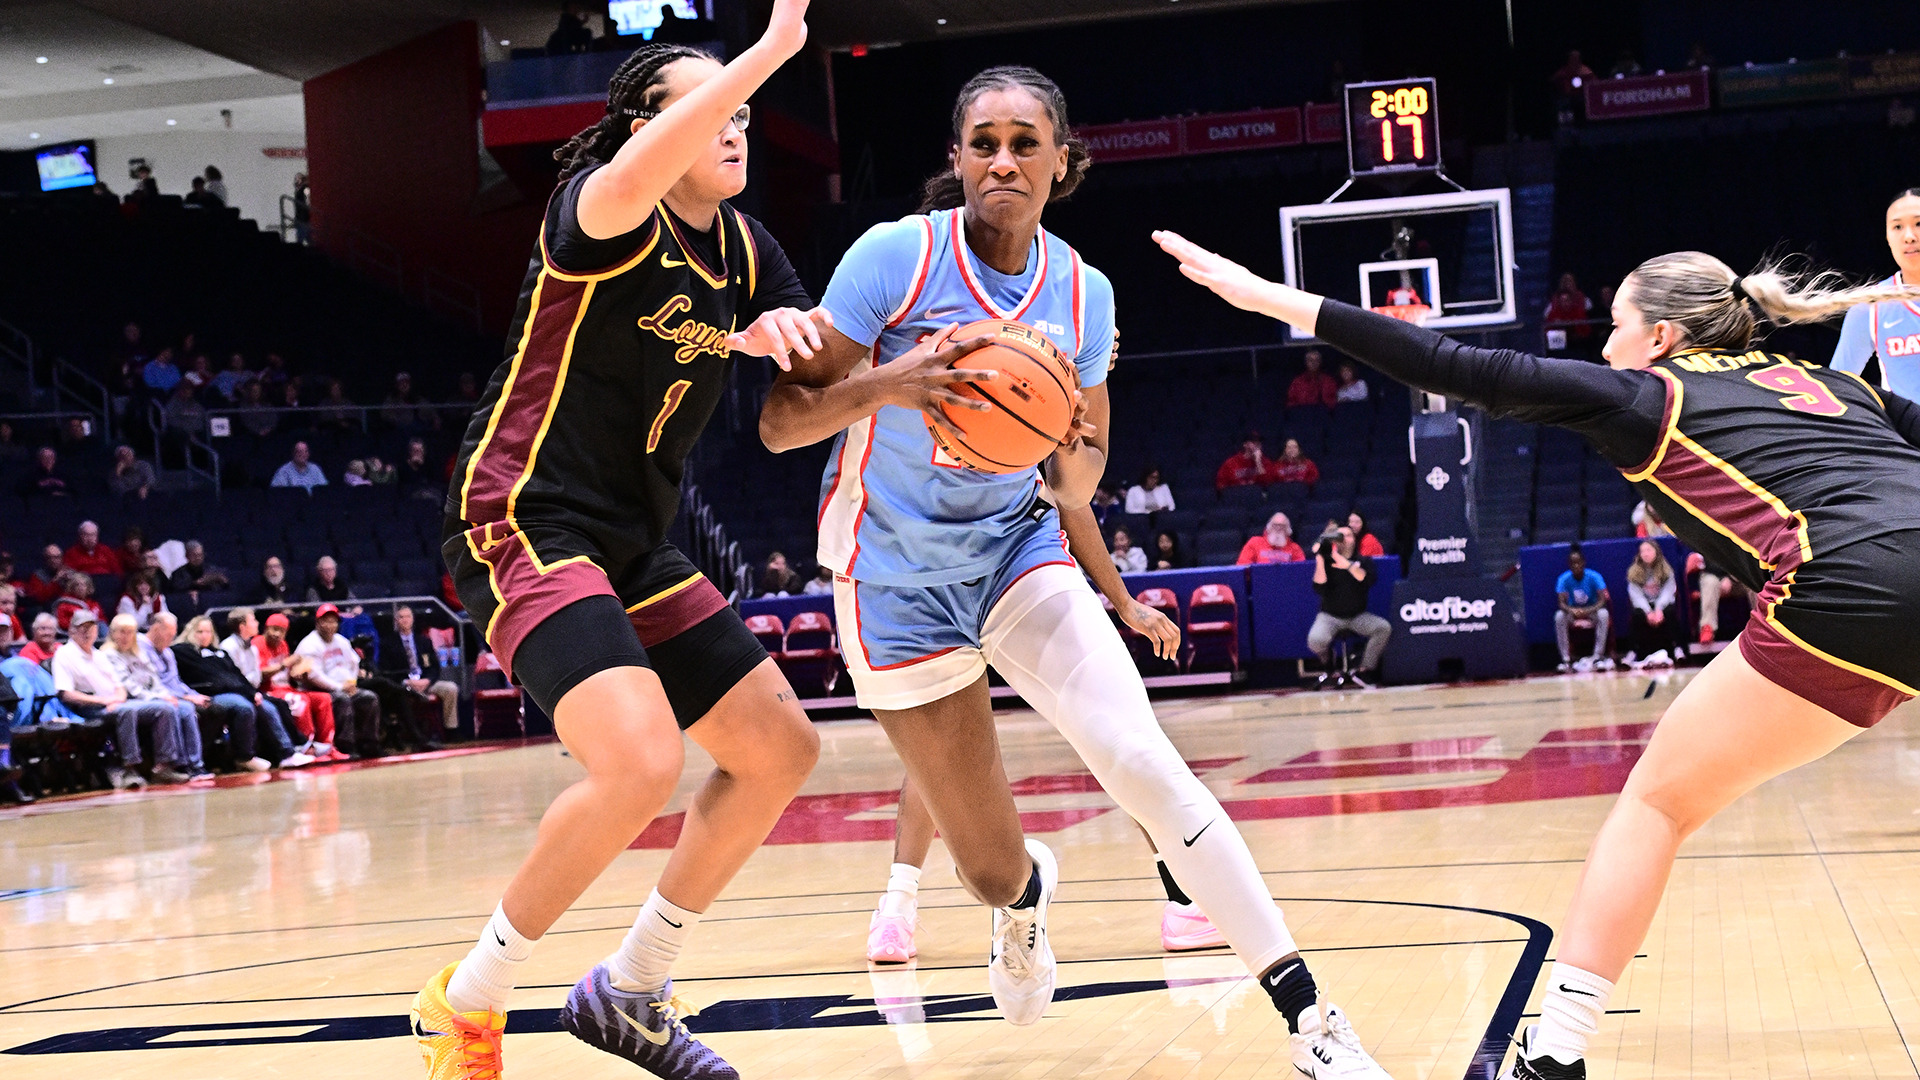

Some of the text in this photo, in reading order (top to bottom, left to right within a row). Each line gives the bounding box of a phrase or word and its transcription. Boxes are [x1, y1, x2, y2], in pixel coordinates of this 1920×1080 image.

[1371, 87, 1429, 118] 2:00
[1602, 84, 1691, 106] FORDHAM
[1208, 121, 1276, 141] DAYTON
[1381, 115, 1424, 161] 17
[1745, 362, 1849, 417] 9
[646, 379, 693, 454] 1
[1417, 536, 1468, 552] Premier
[1422, 550, 1466, 565] Health
[1400, 596, 1496, 624] altafiber
